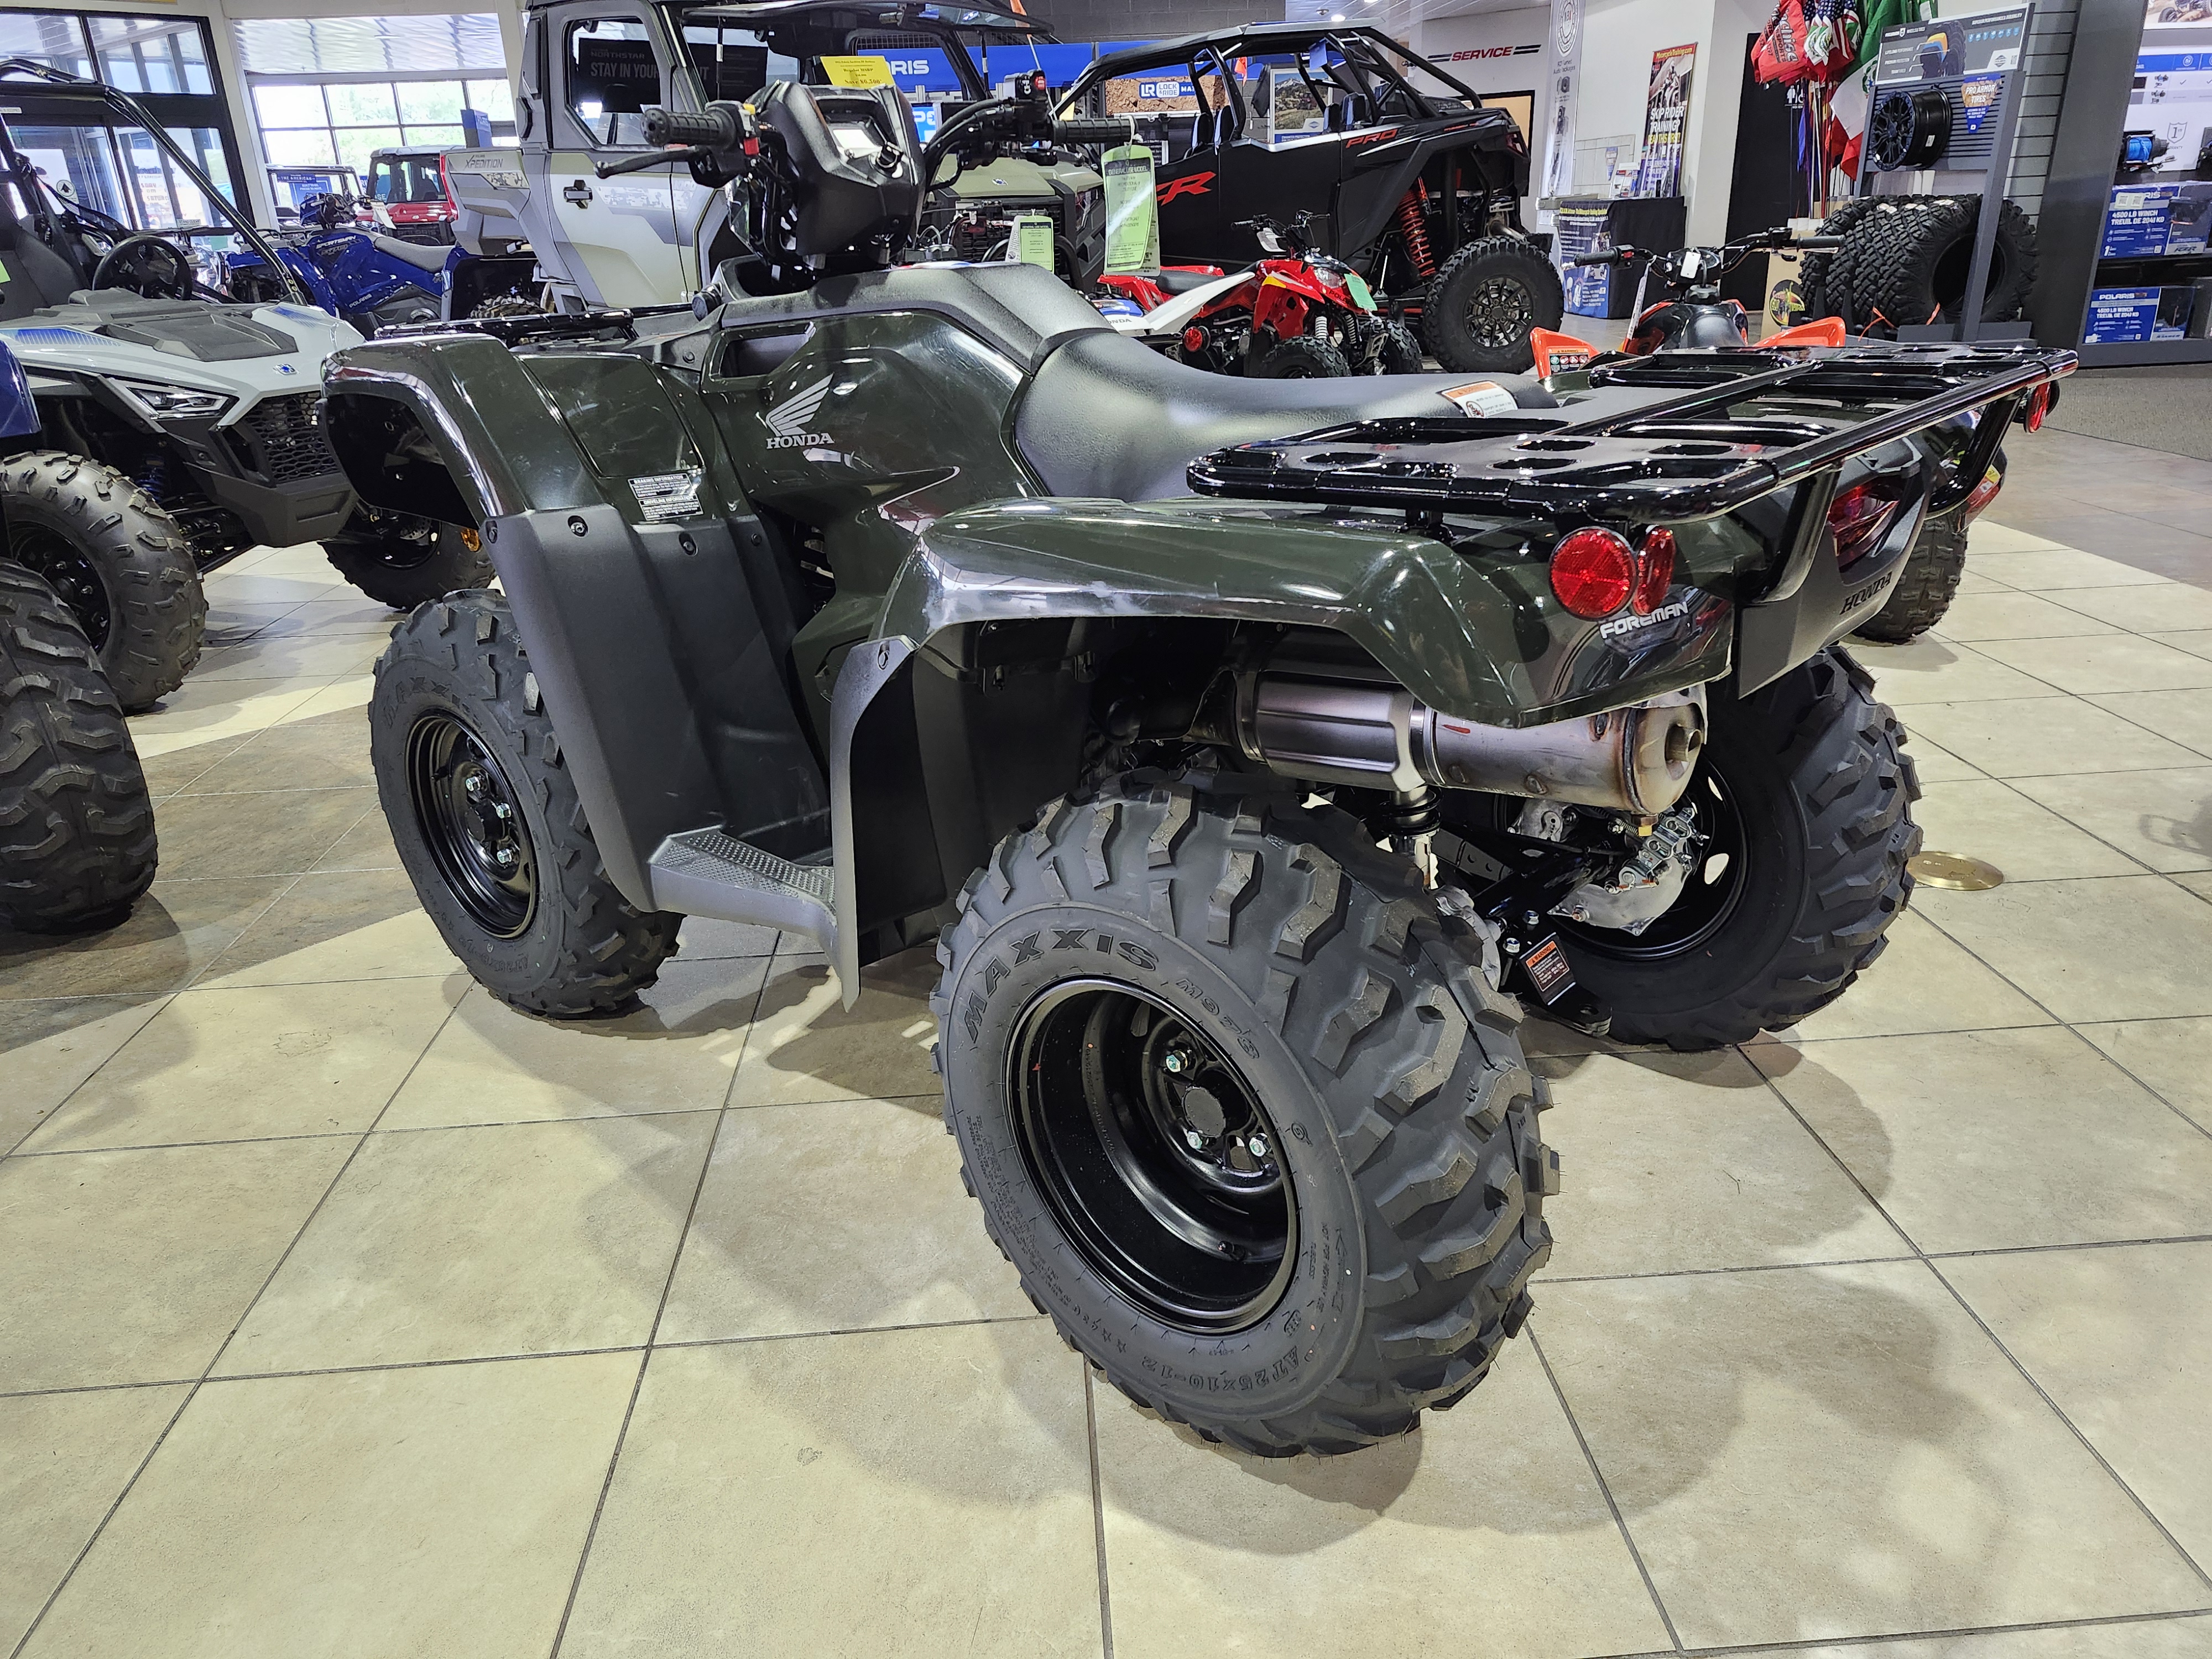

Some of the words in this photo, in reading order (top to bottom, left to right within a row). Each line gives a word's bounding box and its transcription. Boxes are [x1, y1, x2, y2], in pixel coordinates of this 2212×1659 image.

[1452, 46, 1513, 61] SERVICE
[591, 62, 618, 77] STAY
[620, 63, 630, 78] IN
[1141, 84, 1155, 97] LR
[1977, 84, 1996, 93] ARMOR
[1971, 95, 1986, 103] TIRES
[1650, 107, 1664, 120] SKIP
[1665, 106, 1684, 118] RIDER
[1650, 120, 1681, 133] TRAINING?
[1345, 129, 1398, 148] PRO
[463, 155, 503, 171] XPEDITION
[349, 294, 372, 308] POLARIS
[766, 433, 835, 449] HONDA
[1839, 571, 1892, 615] HONDA
[1600, 601, 1688, 639] FOREMAN
[1533, 946, 1552, 960] WARNING
[963, 928, 1159, 1044] MAXXIS
